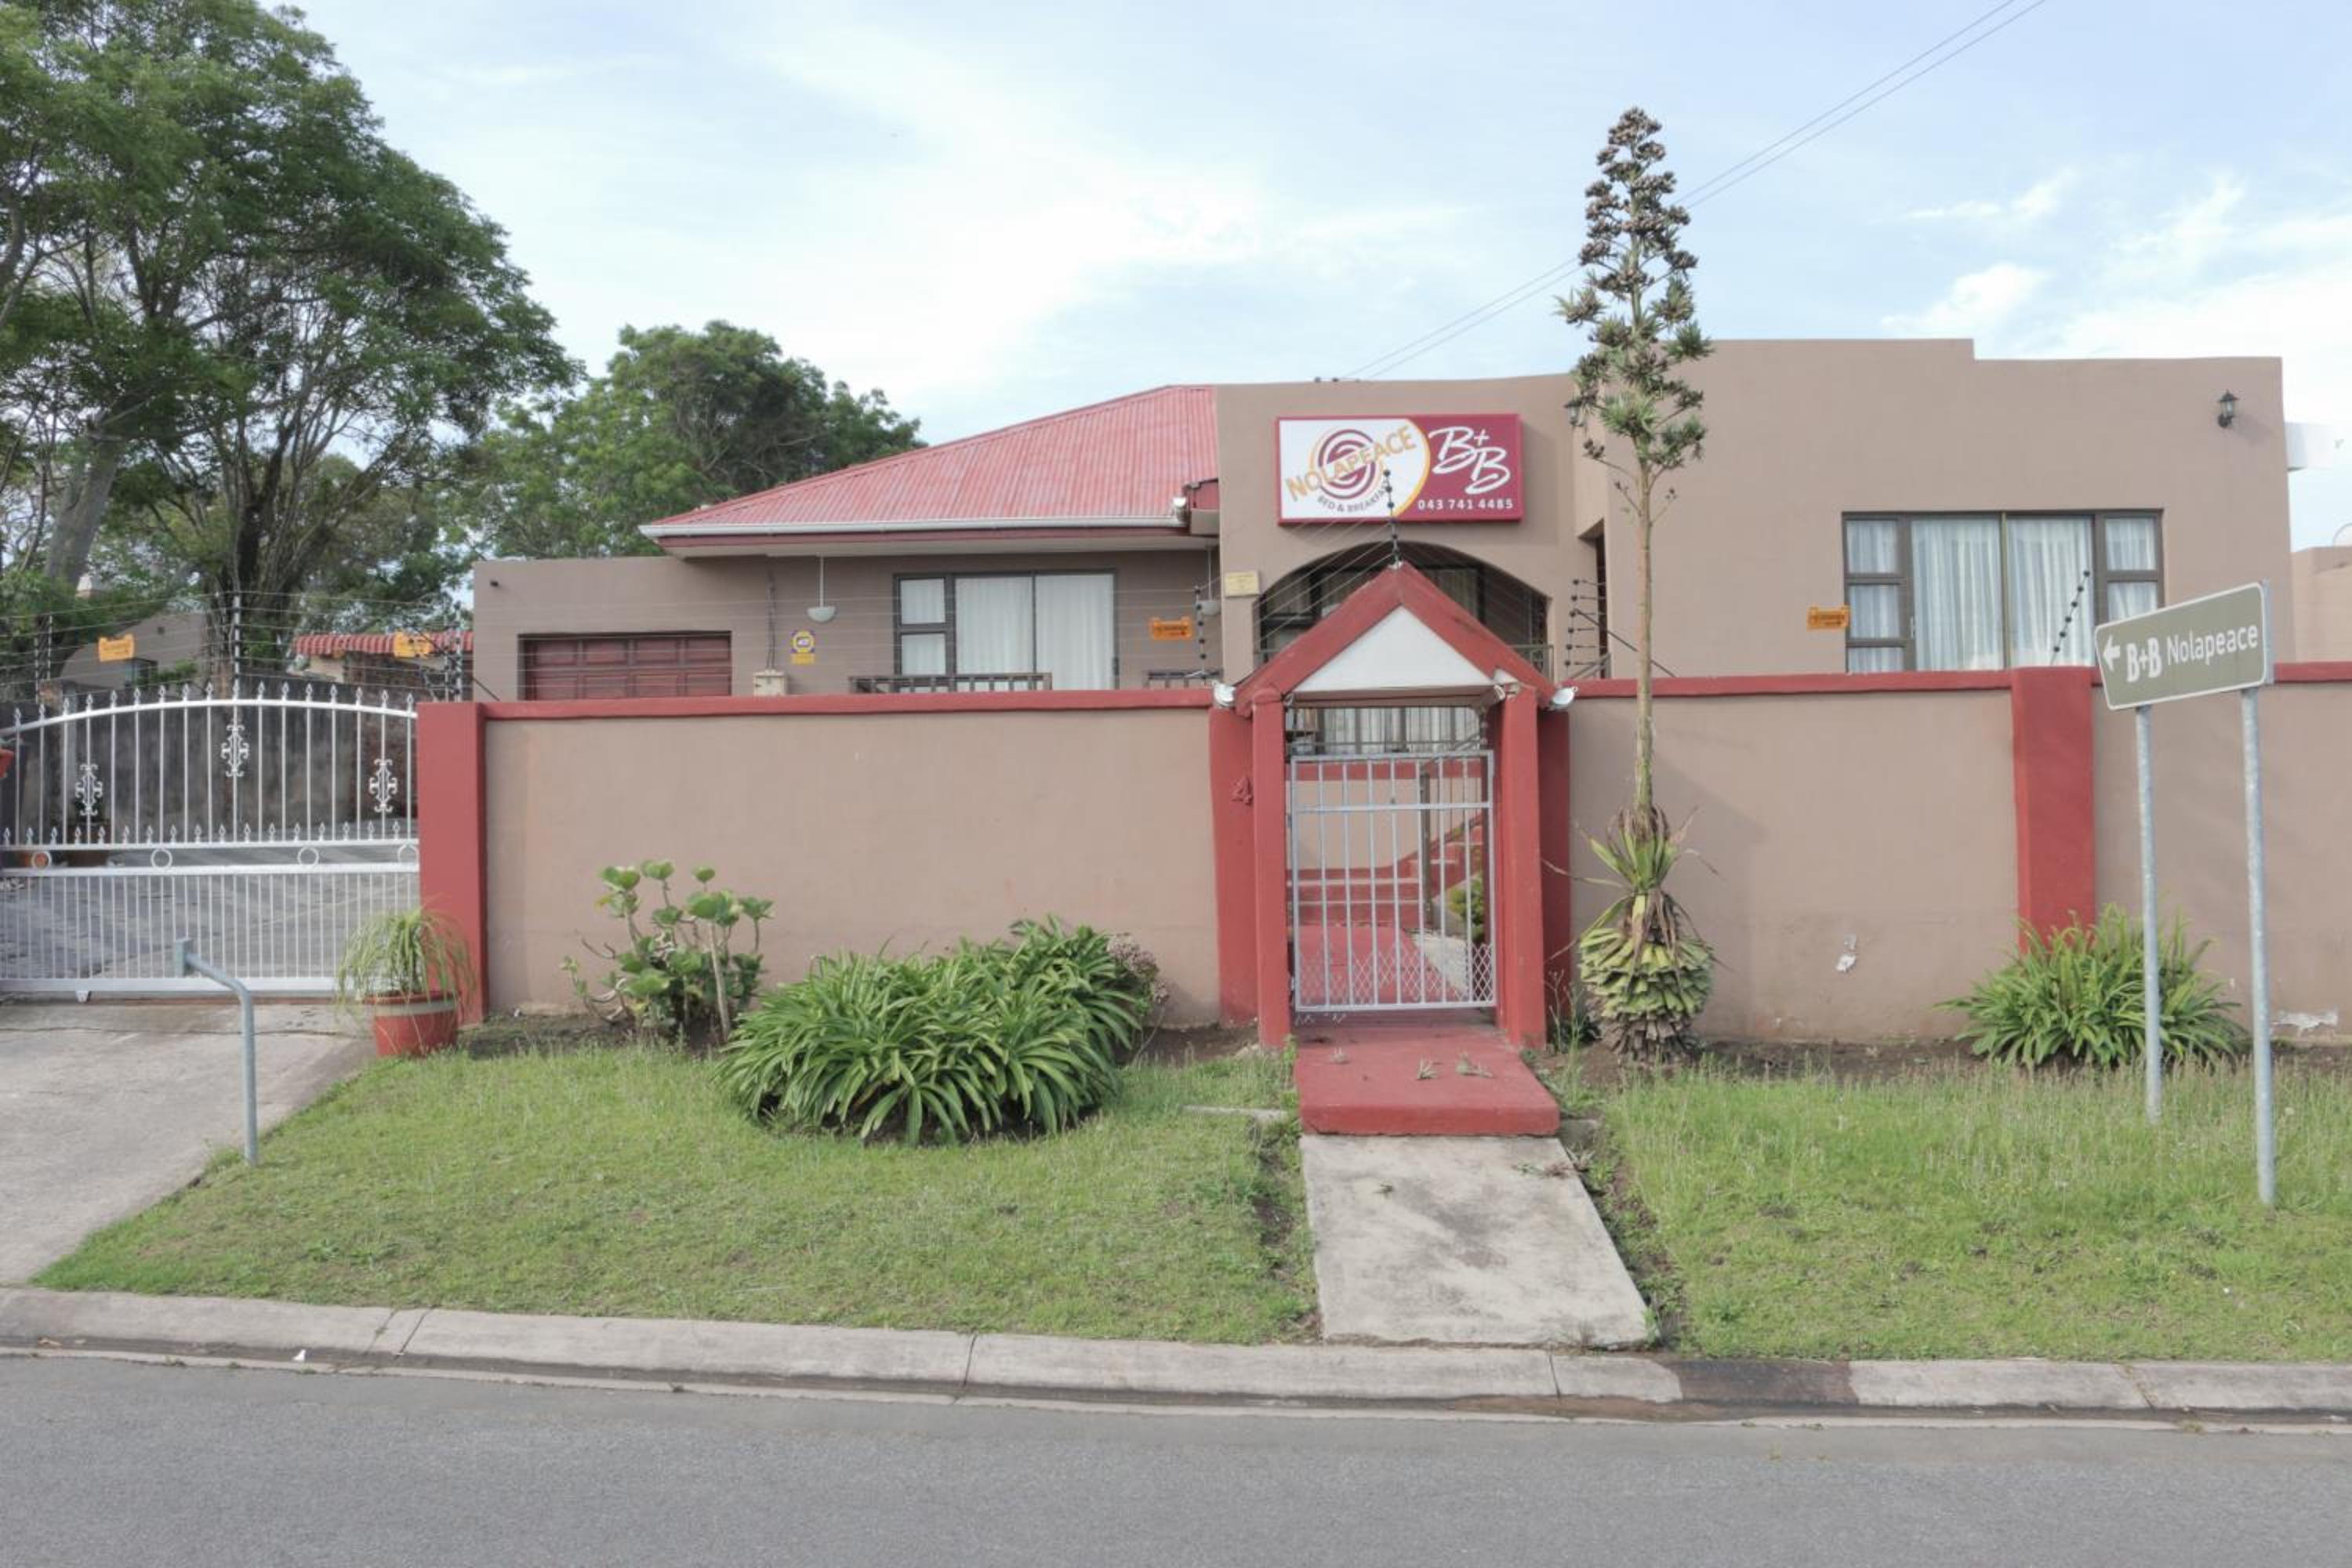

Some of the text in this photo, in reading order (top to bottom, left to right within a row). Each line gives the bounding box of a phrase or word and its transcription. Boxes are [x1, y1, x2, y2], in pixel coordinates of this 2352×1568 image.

[1317, 495, 1335, 510] BED
[1417, 499, 1443, 510] 043
[1448, 499, 1473, 510] 741
[2126, 625, 2258, 682] B+B Nolapeace
